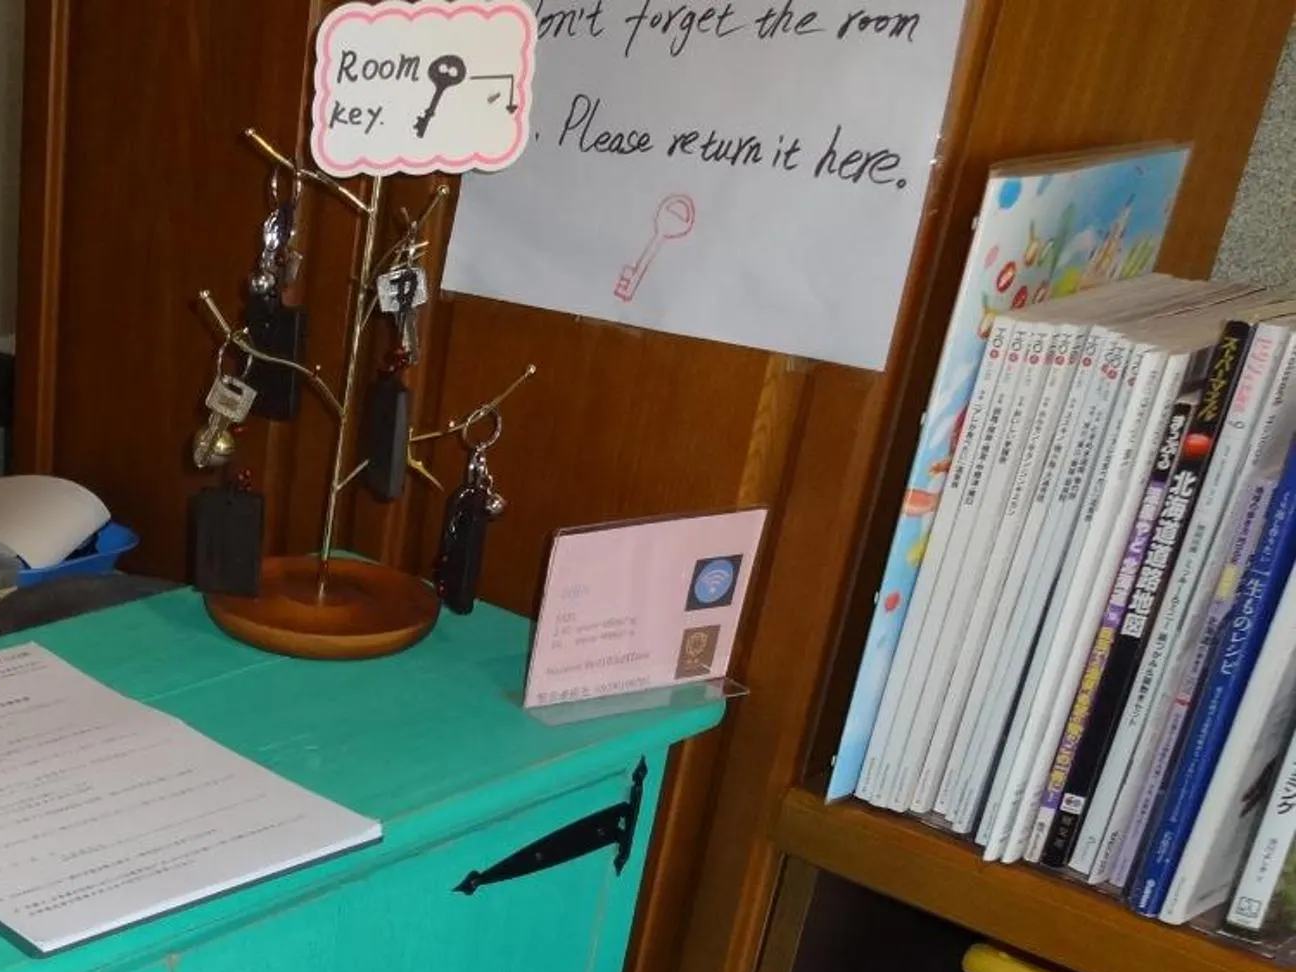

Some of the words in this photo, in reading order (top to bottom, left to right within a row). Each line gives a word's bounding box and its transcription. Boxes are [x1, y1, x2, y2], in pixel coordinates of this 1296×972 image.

[535, 0, 604, 40] on't
[624, 0, 745, 57] forget
[756, 0, 826, 39] the
[837, 10, 920, 42] room
[337, 50, 420, 84] Room
[329, 101, 384, 134] key.
[559, 95, 653, 154] Please
[667, 130, 762, 166] return
[772, 132, 801, 169] it
[814, 126, 908, 189] here.
